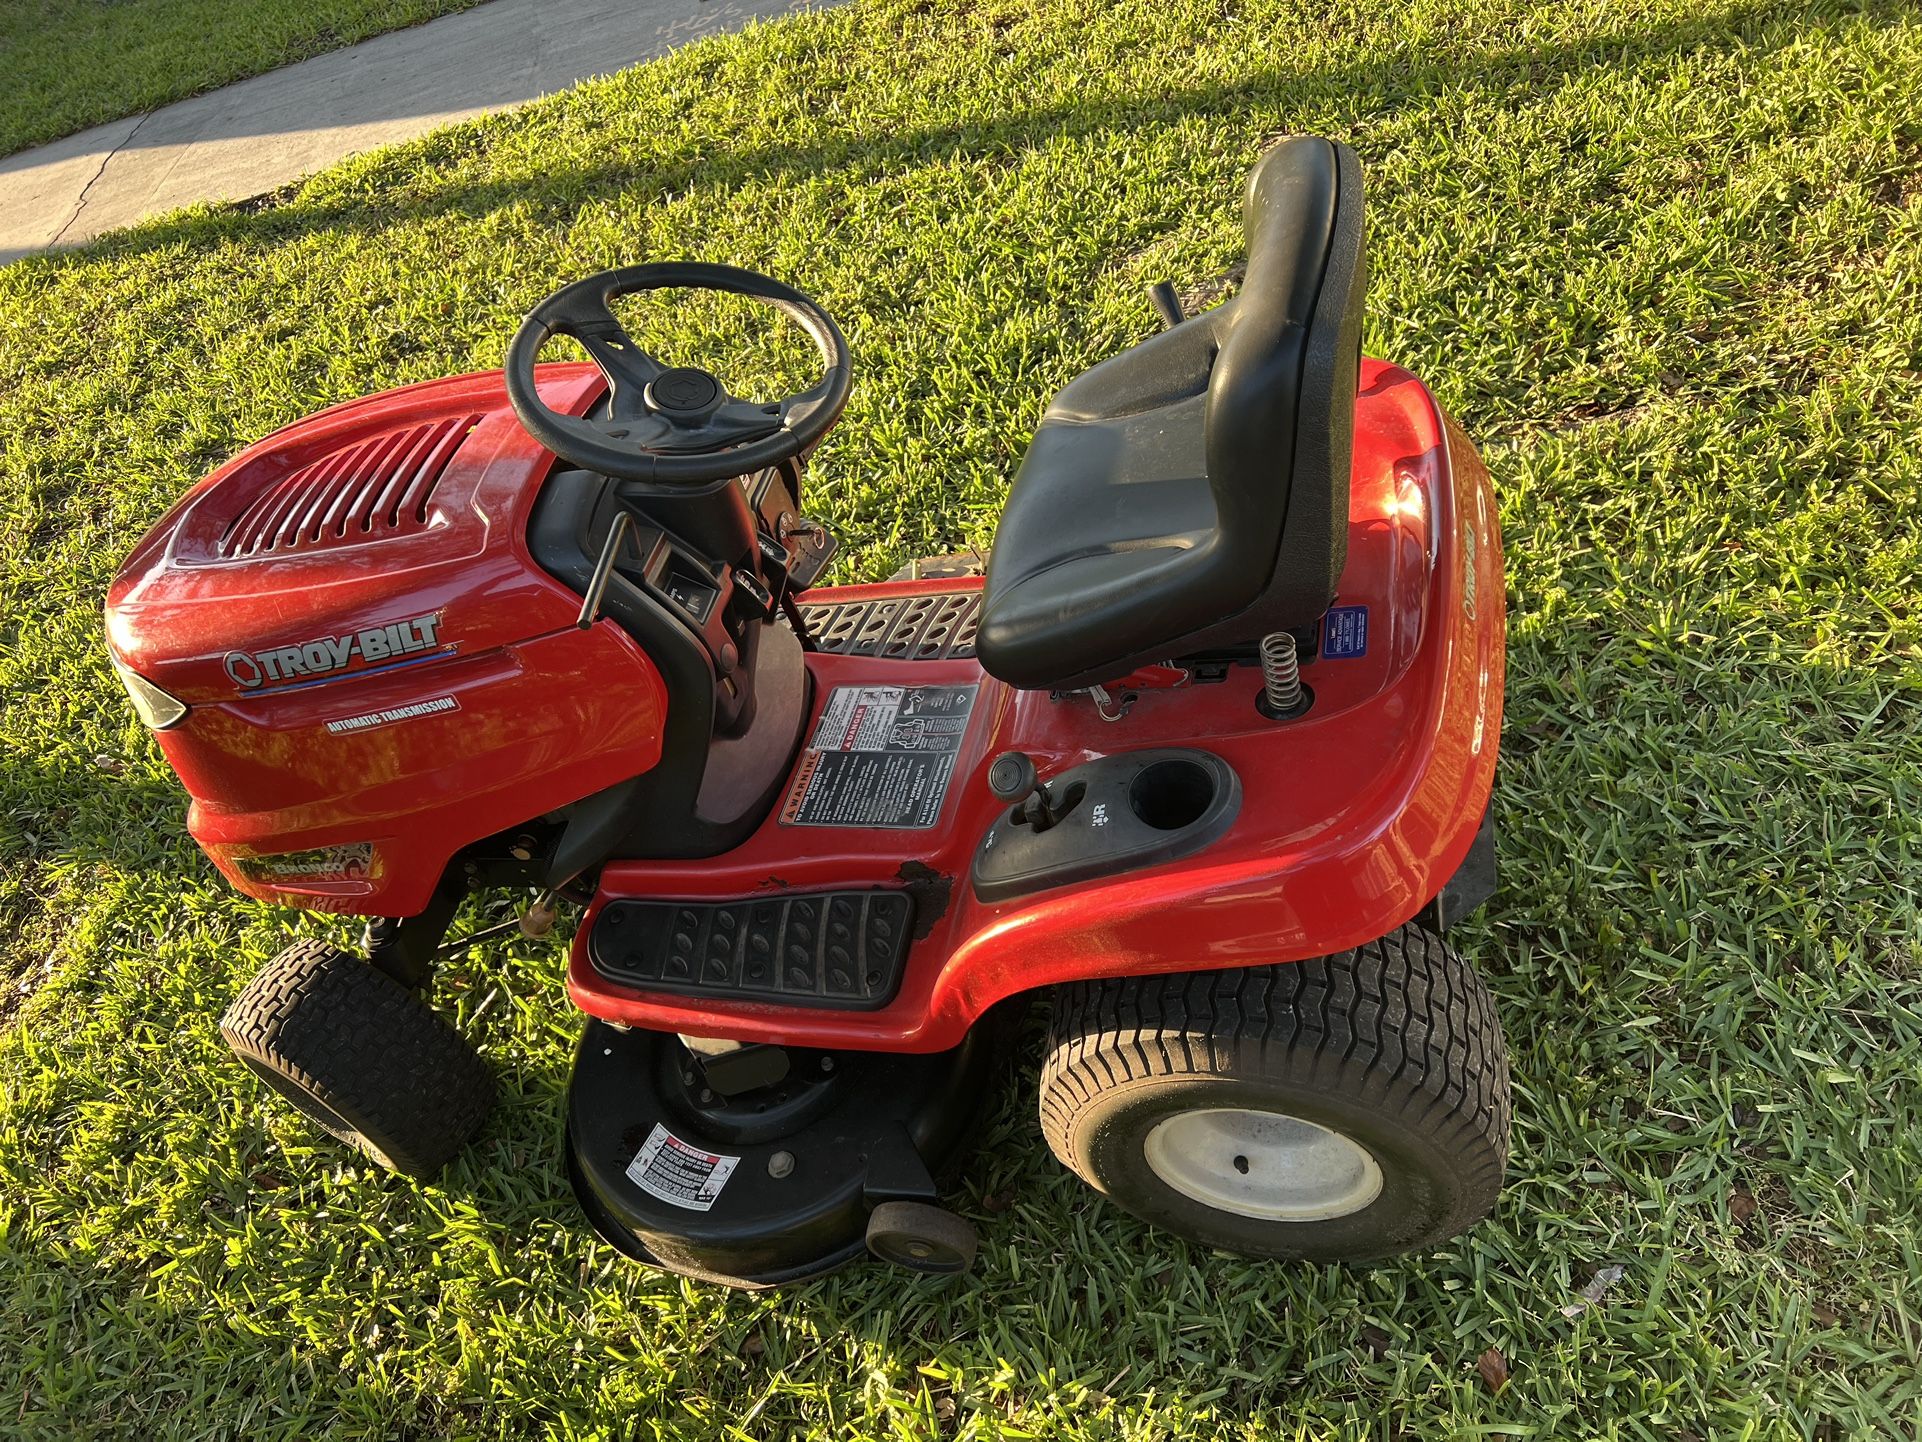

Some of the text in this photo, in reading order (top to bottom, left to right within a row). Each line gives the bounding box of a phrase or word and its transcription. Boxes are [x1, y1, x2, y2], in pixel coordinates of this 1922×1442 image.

[255, 616, 438, 681] TROY-BILT
[326, 698, 456, 734] AUTOMATIC TRANSMISSION
[846, 708, 864, 740] DANGER
[795, 813, 802, 821] TO
[680, 1145, 708, 1161] DANGER
